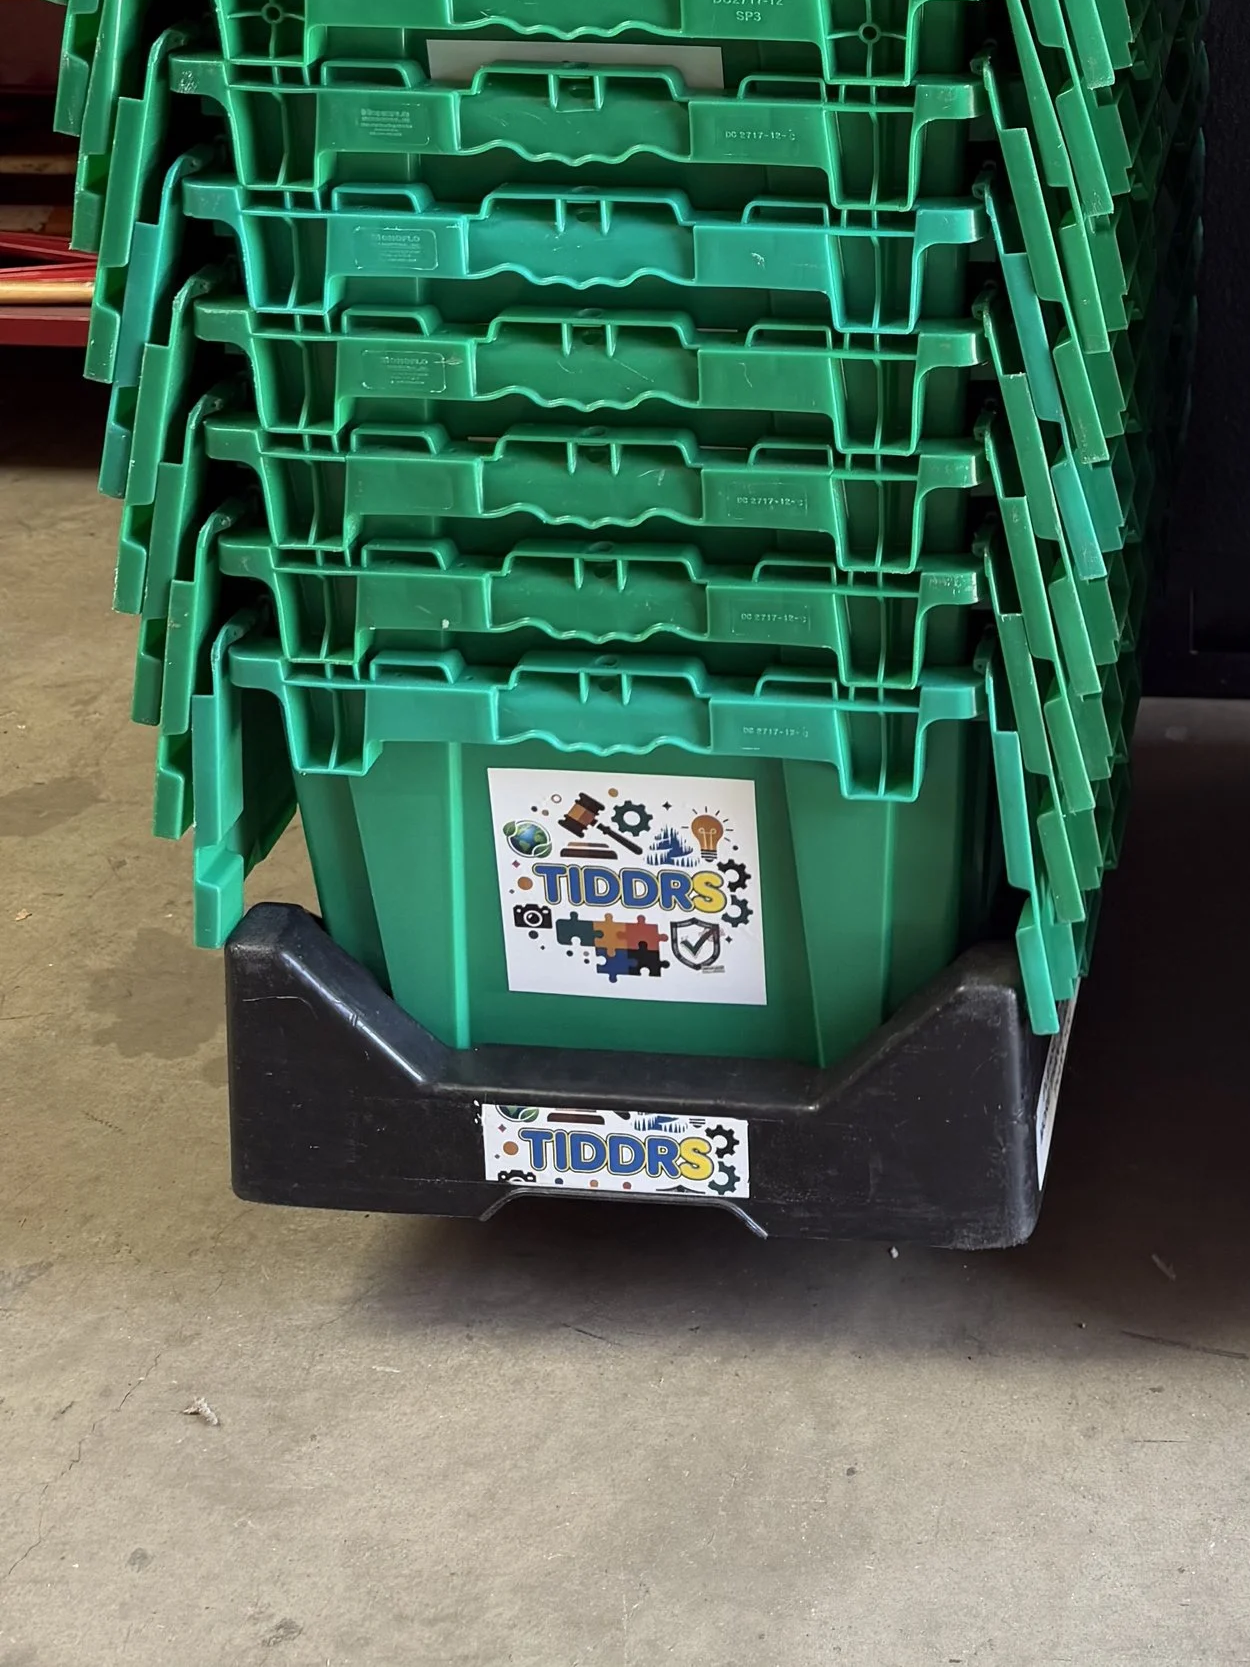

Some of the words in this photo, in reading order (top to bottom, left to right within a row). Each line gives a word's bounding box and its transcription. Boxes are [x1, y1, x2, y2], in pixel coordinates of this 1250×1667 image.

[736, 10, 762, 22] SP3
[532, 863, 727, 913] TIDDRS
[518, 1128, 714, 1180] TIDDRS
